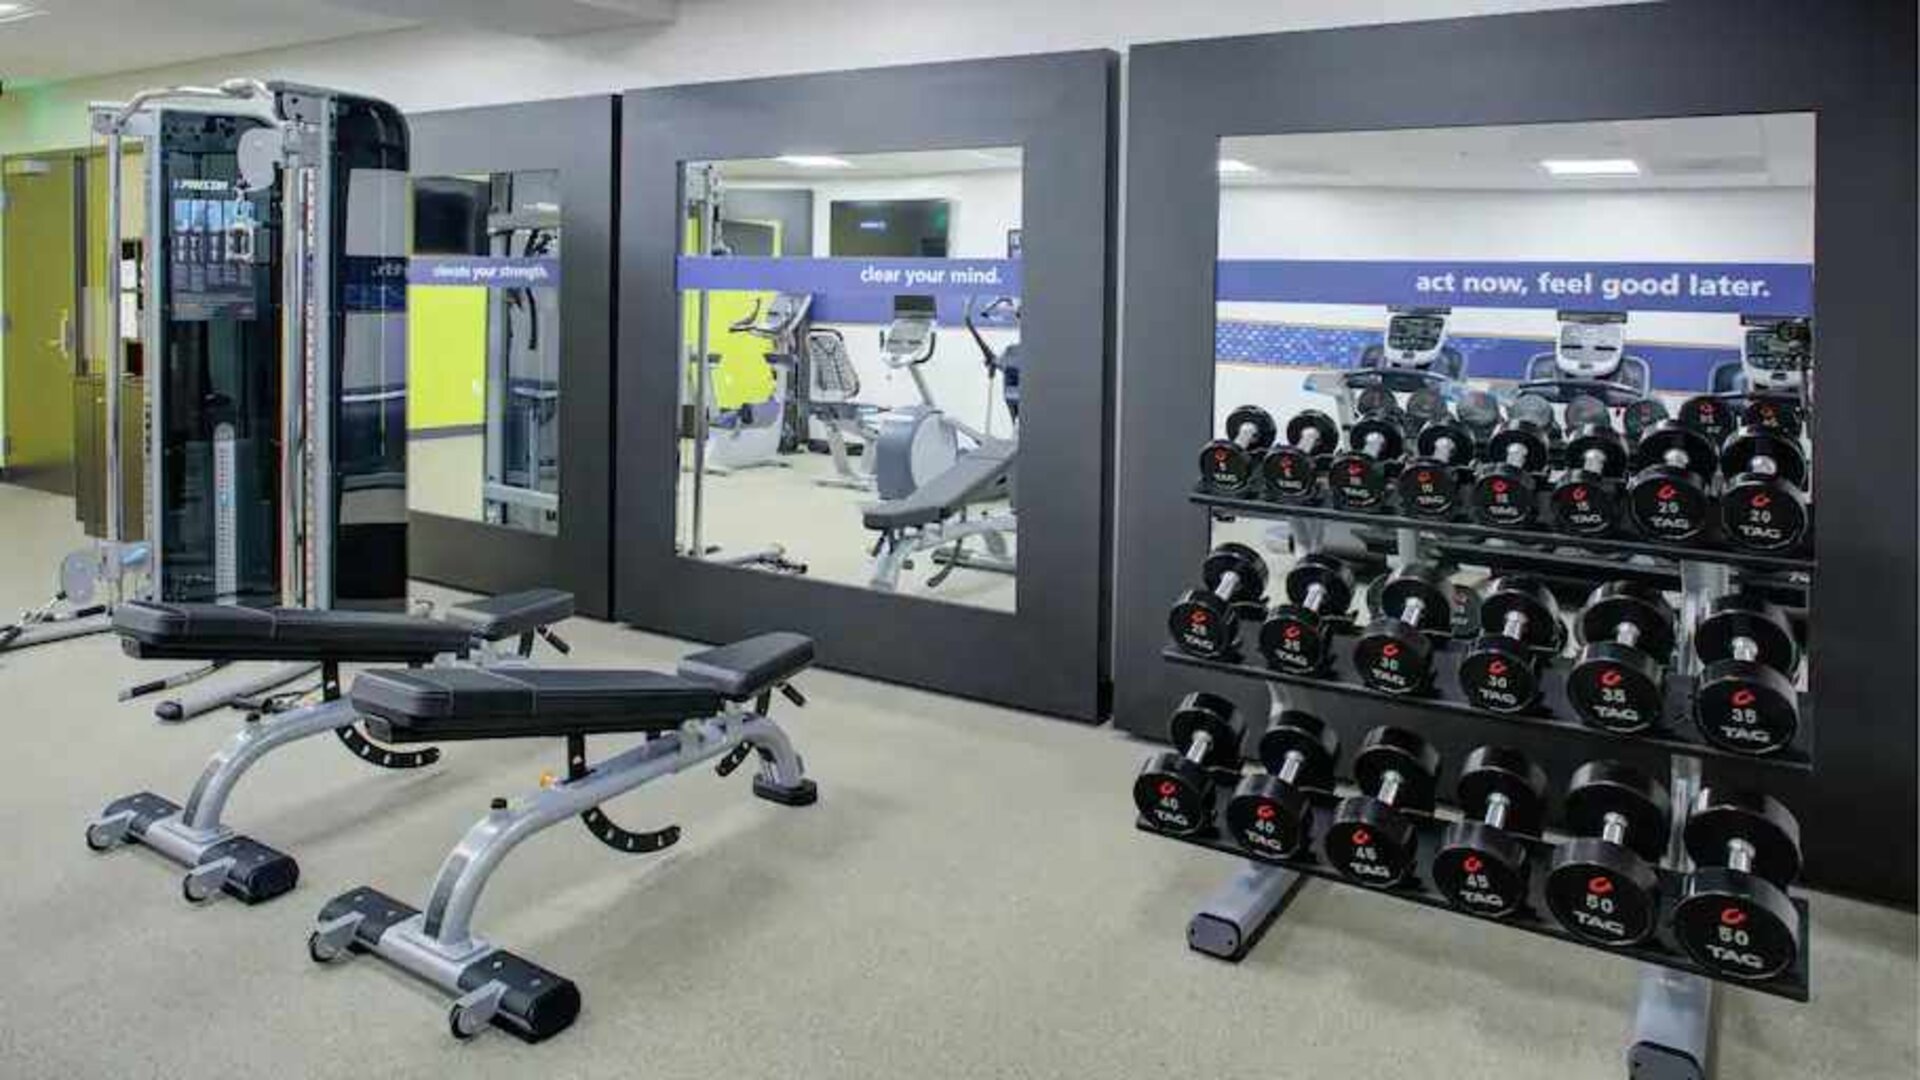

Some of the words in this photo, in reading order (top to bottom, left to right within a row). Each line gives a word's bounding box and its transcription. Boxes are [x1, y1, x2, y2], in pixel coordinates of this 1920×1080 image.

[471, 266, 498, 282] your
[860, 264, 901, 283] clear
[905, 269, 946, 287] your
[951, 266, 1003, 285] mind.
[1415, 274, 1455, 293] act
[1463, 275, 1528, 297] now,
[1537, 272, 1592, 295] feel
[1601, 273, 1679, 300] good
[1689, 273, 1772, 298] later.
[1658, 501, 1679, 514] 20
[1750, 509, 1772, 522] 20
[1569, 513, 1603, 524] TAG
[1652, 516, 1689, 530] TAG
[1739, 525, 1782, 540] TAG
[1183, 633, 1214, 650] TAG
[1277, 650, 1309, 667] TAG
[1380, 656, 1399, 669] 30
[1371, 668, 1406, 686] TAG
[1488, 674, 1508, 688] 30
[1479, 687, 1518, 705] TAG
[1602, 687, 1626, 702] 35
[1592, 704, 1639, 722] TAG
[1731, 707, 1757, 723] 35
[1720, 726, 1771, 743] TAG
[1160, 798, 1178, 811] 40
[1153, 809, 1189, 827] TAG
[1254, 820, 1275, 834] 40
[1246, 831, 1283, 851] TAG
[1355, 847, 1377, 861] 45
[1350, 861, 1391, 879] TAG
[1466, 873, 1489, 890] 45
[1459, 890, 1504, 908] TAG
[1585, 896, 1615, 914] 50
[1573, 911, 1626, 937] TAG
[1718, 927, 1750, 946] 50
[1705, 944, 1765, 969] TAG
